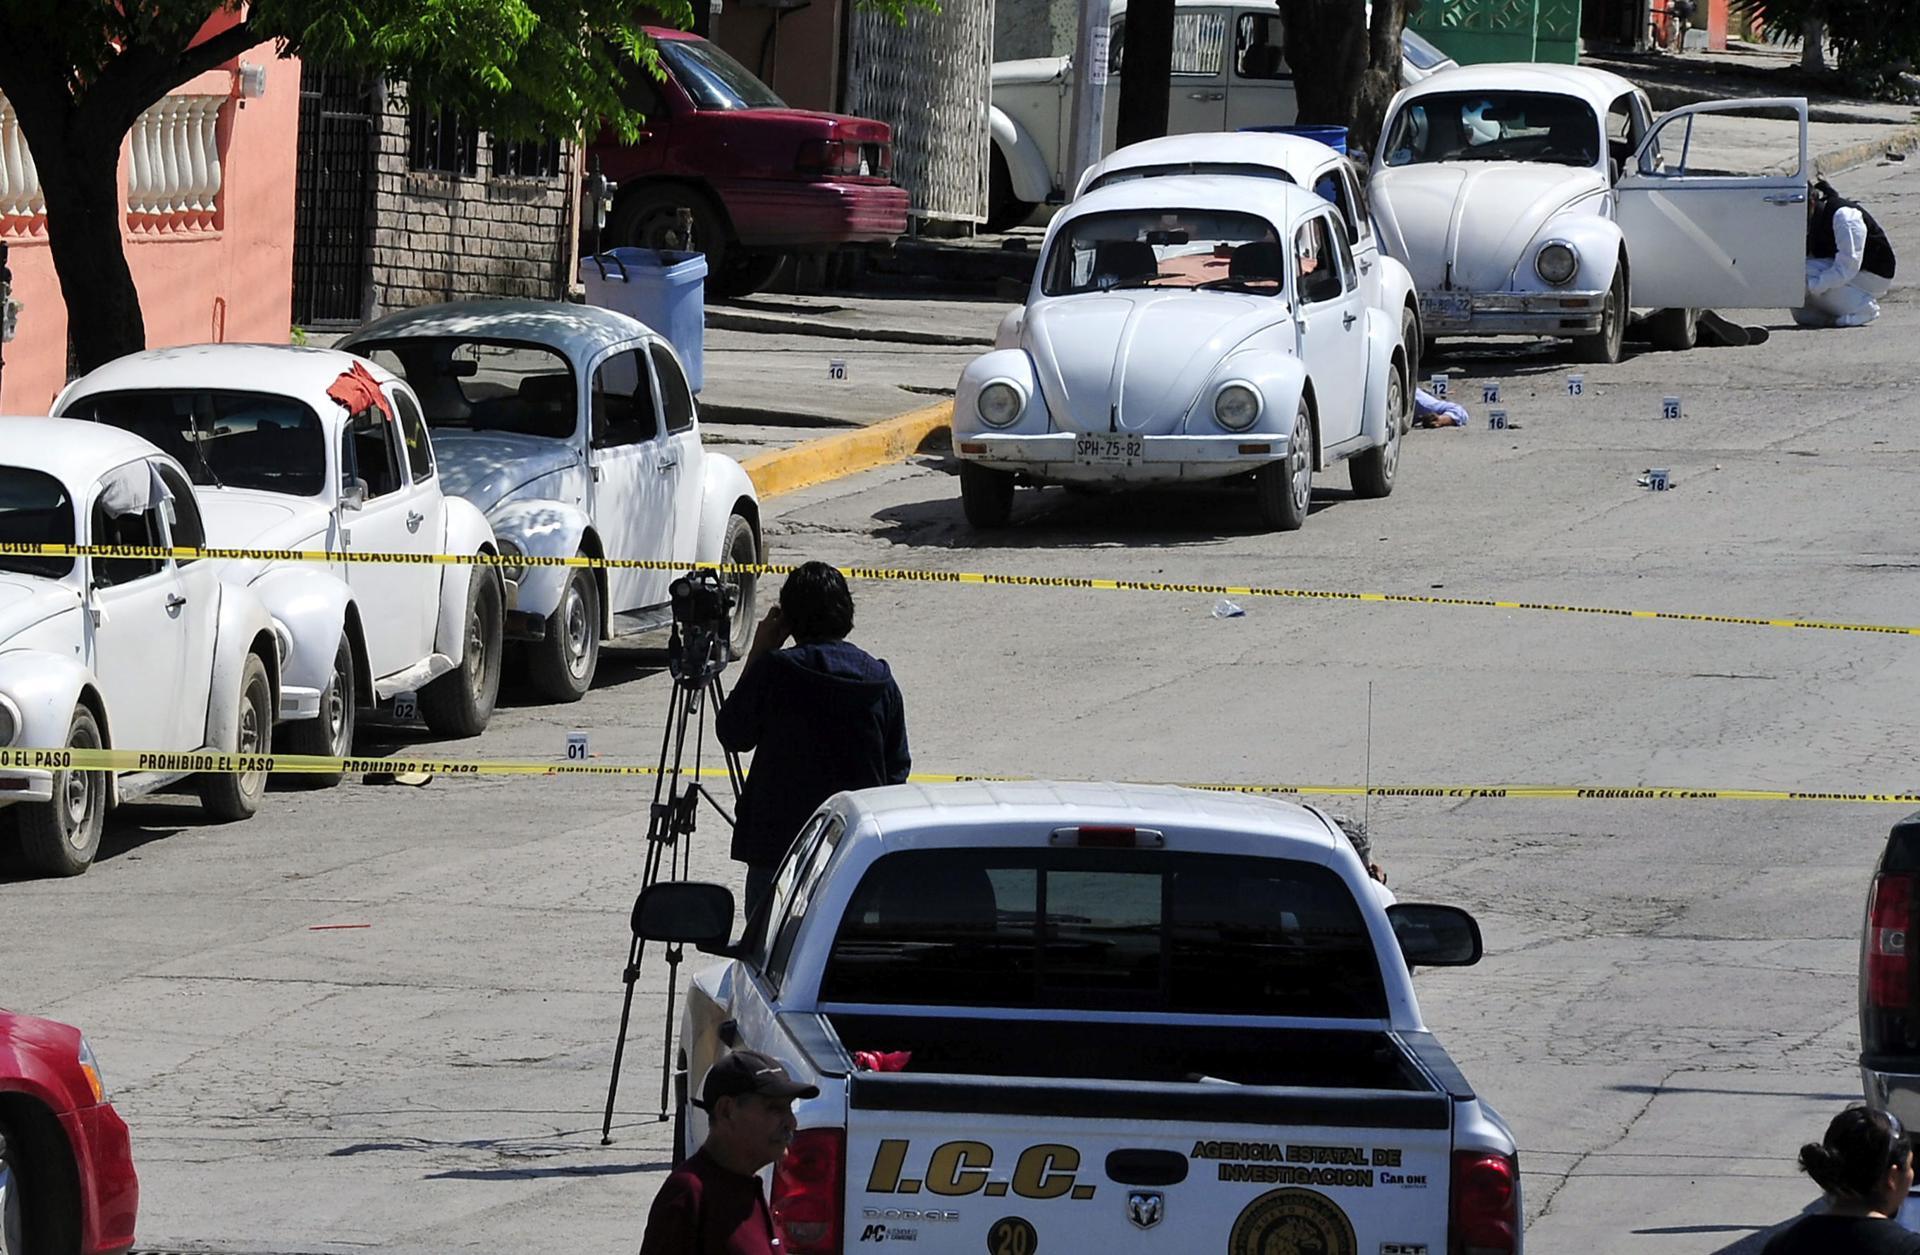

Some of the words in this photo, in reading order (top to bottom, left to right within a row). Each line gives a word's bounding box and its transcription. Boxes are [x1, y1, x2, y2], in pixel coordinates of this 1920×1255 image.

[830, 367, 843, 379] 10
[1432, 383, 1446, 395] 12
[1483, 391, 1497, 403] 14
[1568, 384, 1582, 396] 13
[1663, 406, 1678, 419] 15
[1489, 417, 1504, 430] 16
[1077, 440, 1141, 457] SPH-75-82
[1650, 478, 1665, 491] 18
[395, 704, 413, 718] 02
[568, 743, 584, 759] 01
[15, 751, 30, 767] EL
[35, 752, 71, 768] PASO
[139, 753, 213, 770] PROHIBIDO
[218, 756, 233, 771] EL
[238, 757, 275, 771] PASO
[1190, 1141, 1283, 1162] AGENCIA
[1285, 1145, 1369, 1166] ESTATAL
[1372, 1148, 1402, 1167] DE
[866, 1139, 1096, 1200] I.C.C.
[1218, 1163, 1374, 1187] INVESTIGACION
[863, 1206, 960, 1222] DODGE
[997, 1222, 1027, 1255] 20
